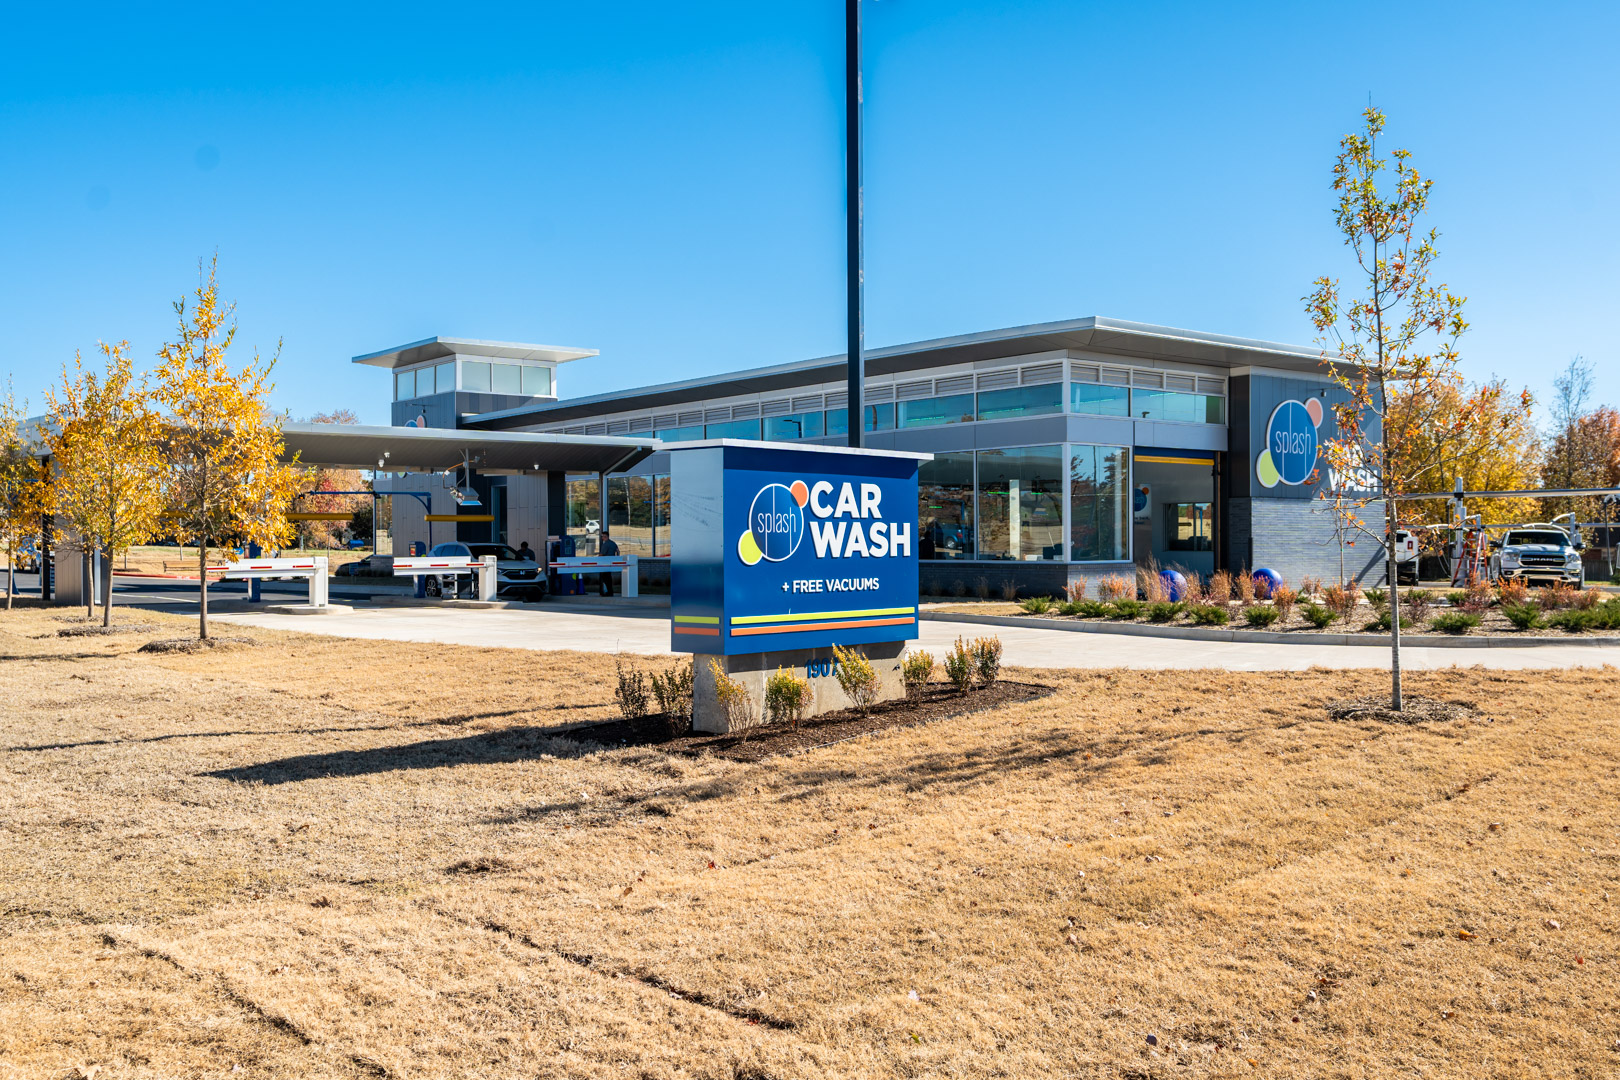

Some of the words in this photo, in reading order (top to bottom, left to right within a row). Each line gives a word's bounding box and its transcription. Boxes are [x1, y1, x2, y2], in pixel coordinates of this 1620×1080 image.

[1327, 467, 1378, 493] WASH
[809, 480, 883, 519] CAR
[808, 521, 911, 558] WASH
[792, 579, 823, 593] FREE
[825, 577, 880, 592] VACUUMS
